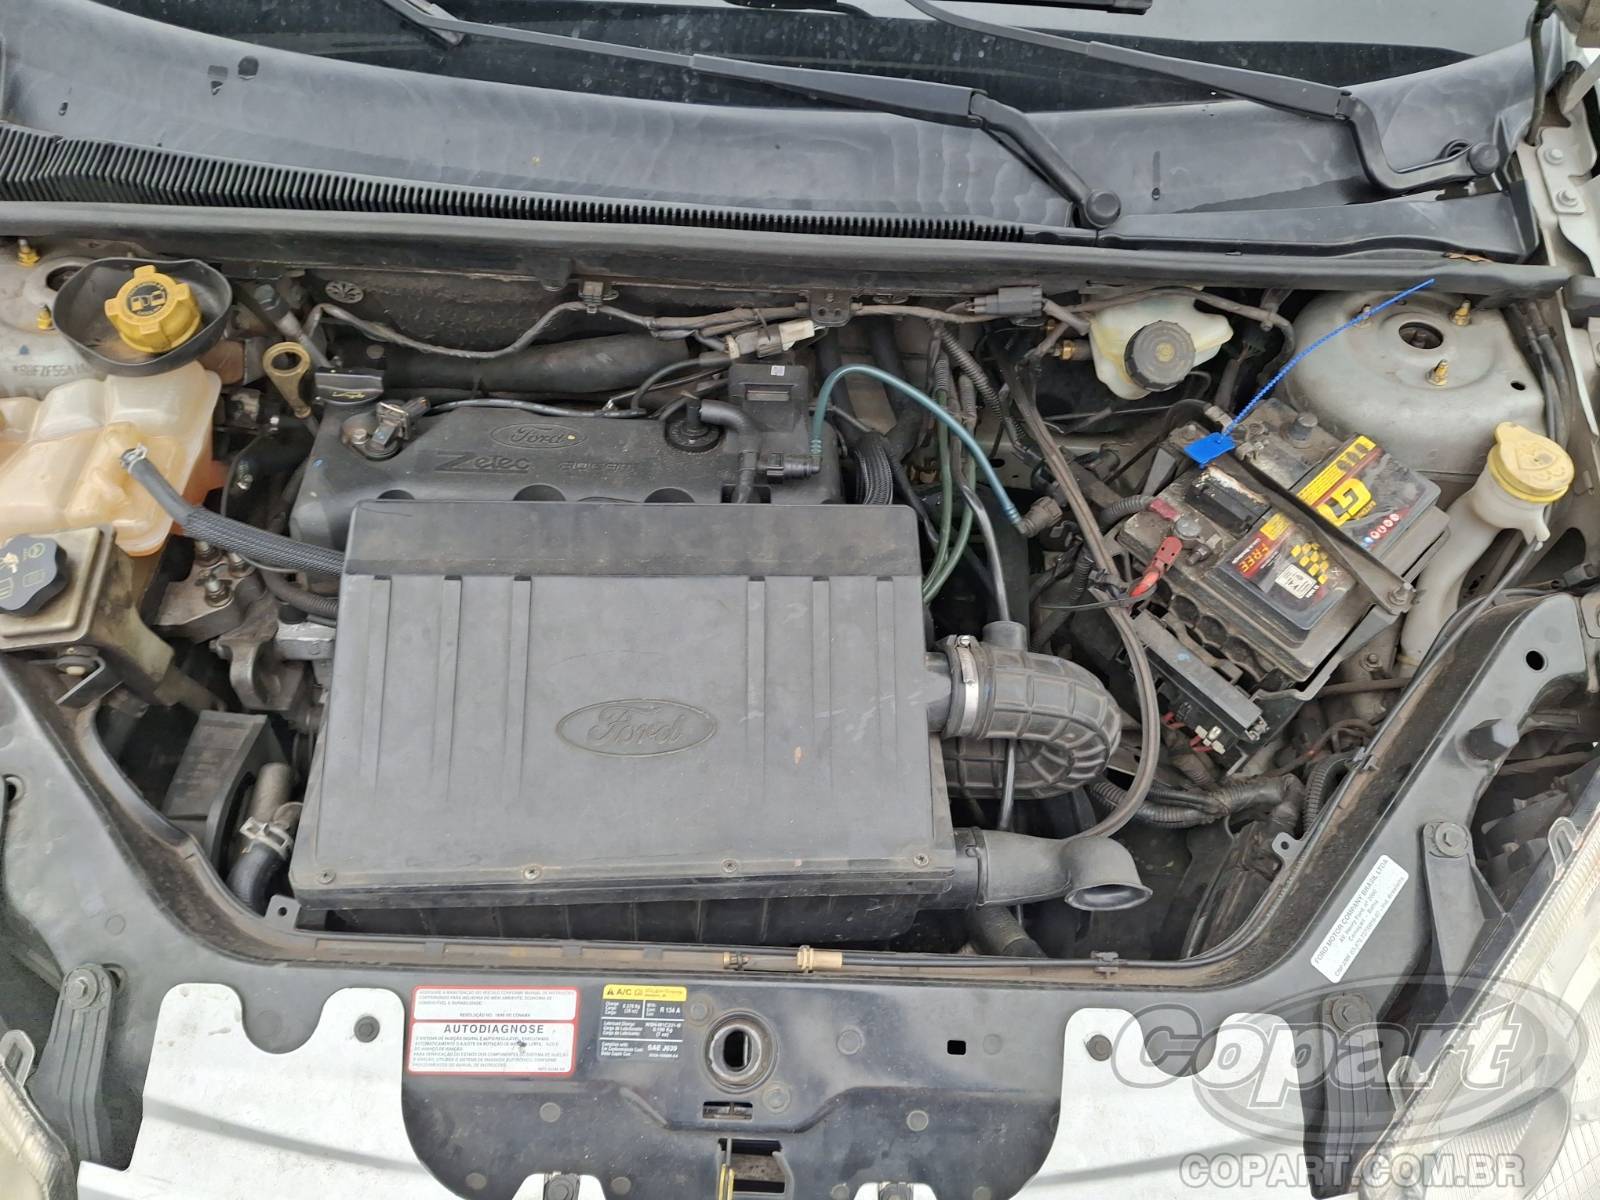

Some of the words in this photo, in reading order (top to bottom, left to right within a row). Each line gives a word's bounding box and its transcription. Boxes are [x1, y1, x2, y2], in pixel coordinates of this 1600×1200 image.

[510, 425, 565, 444] Ford
[435, 451, 530, 474] Zetec
[1239, 543, 1269, 573] FREE
[586, 704, 686, 745] Ford
[1314, 945, 1330, 965] FORD
[1326, 923, 1345, 947] MOTOR
[1340, 894, 1365, 926] COMPANY
[616, 988, 632, 996] A/C
[443, 1024, 544, 1034] AUTODIAGNOSE
